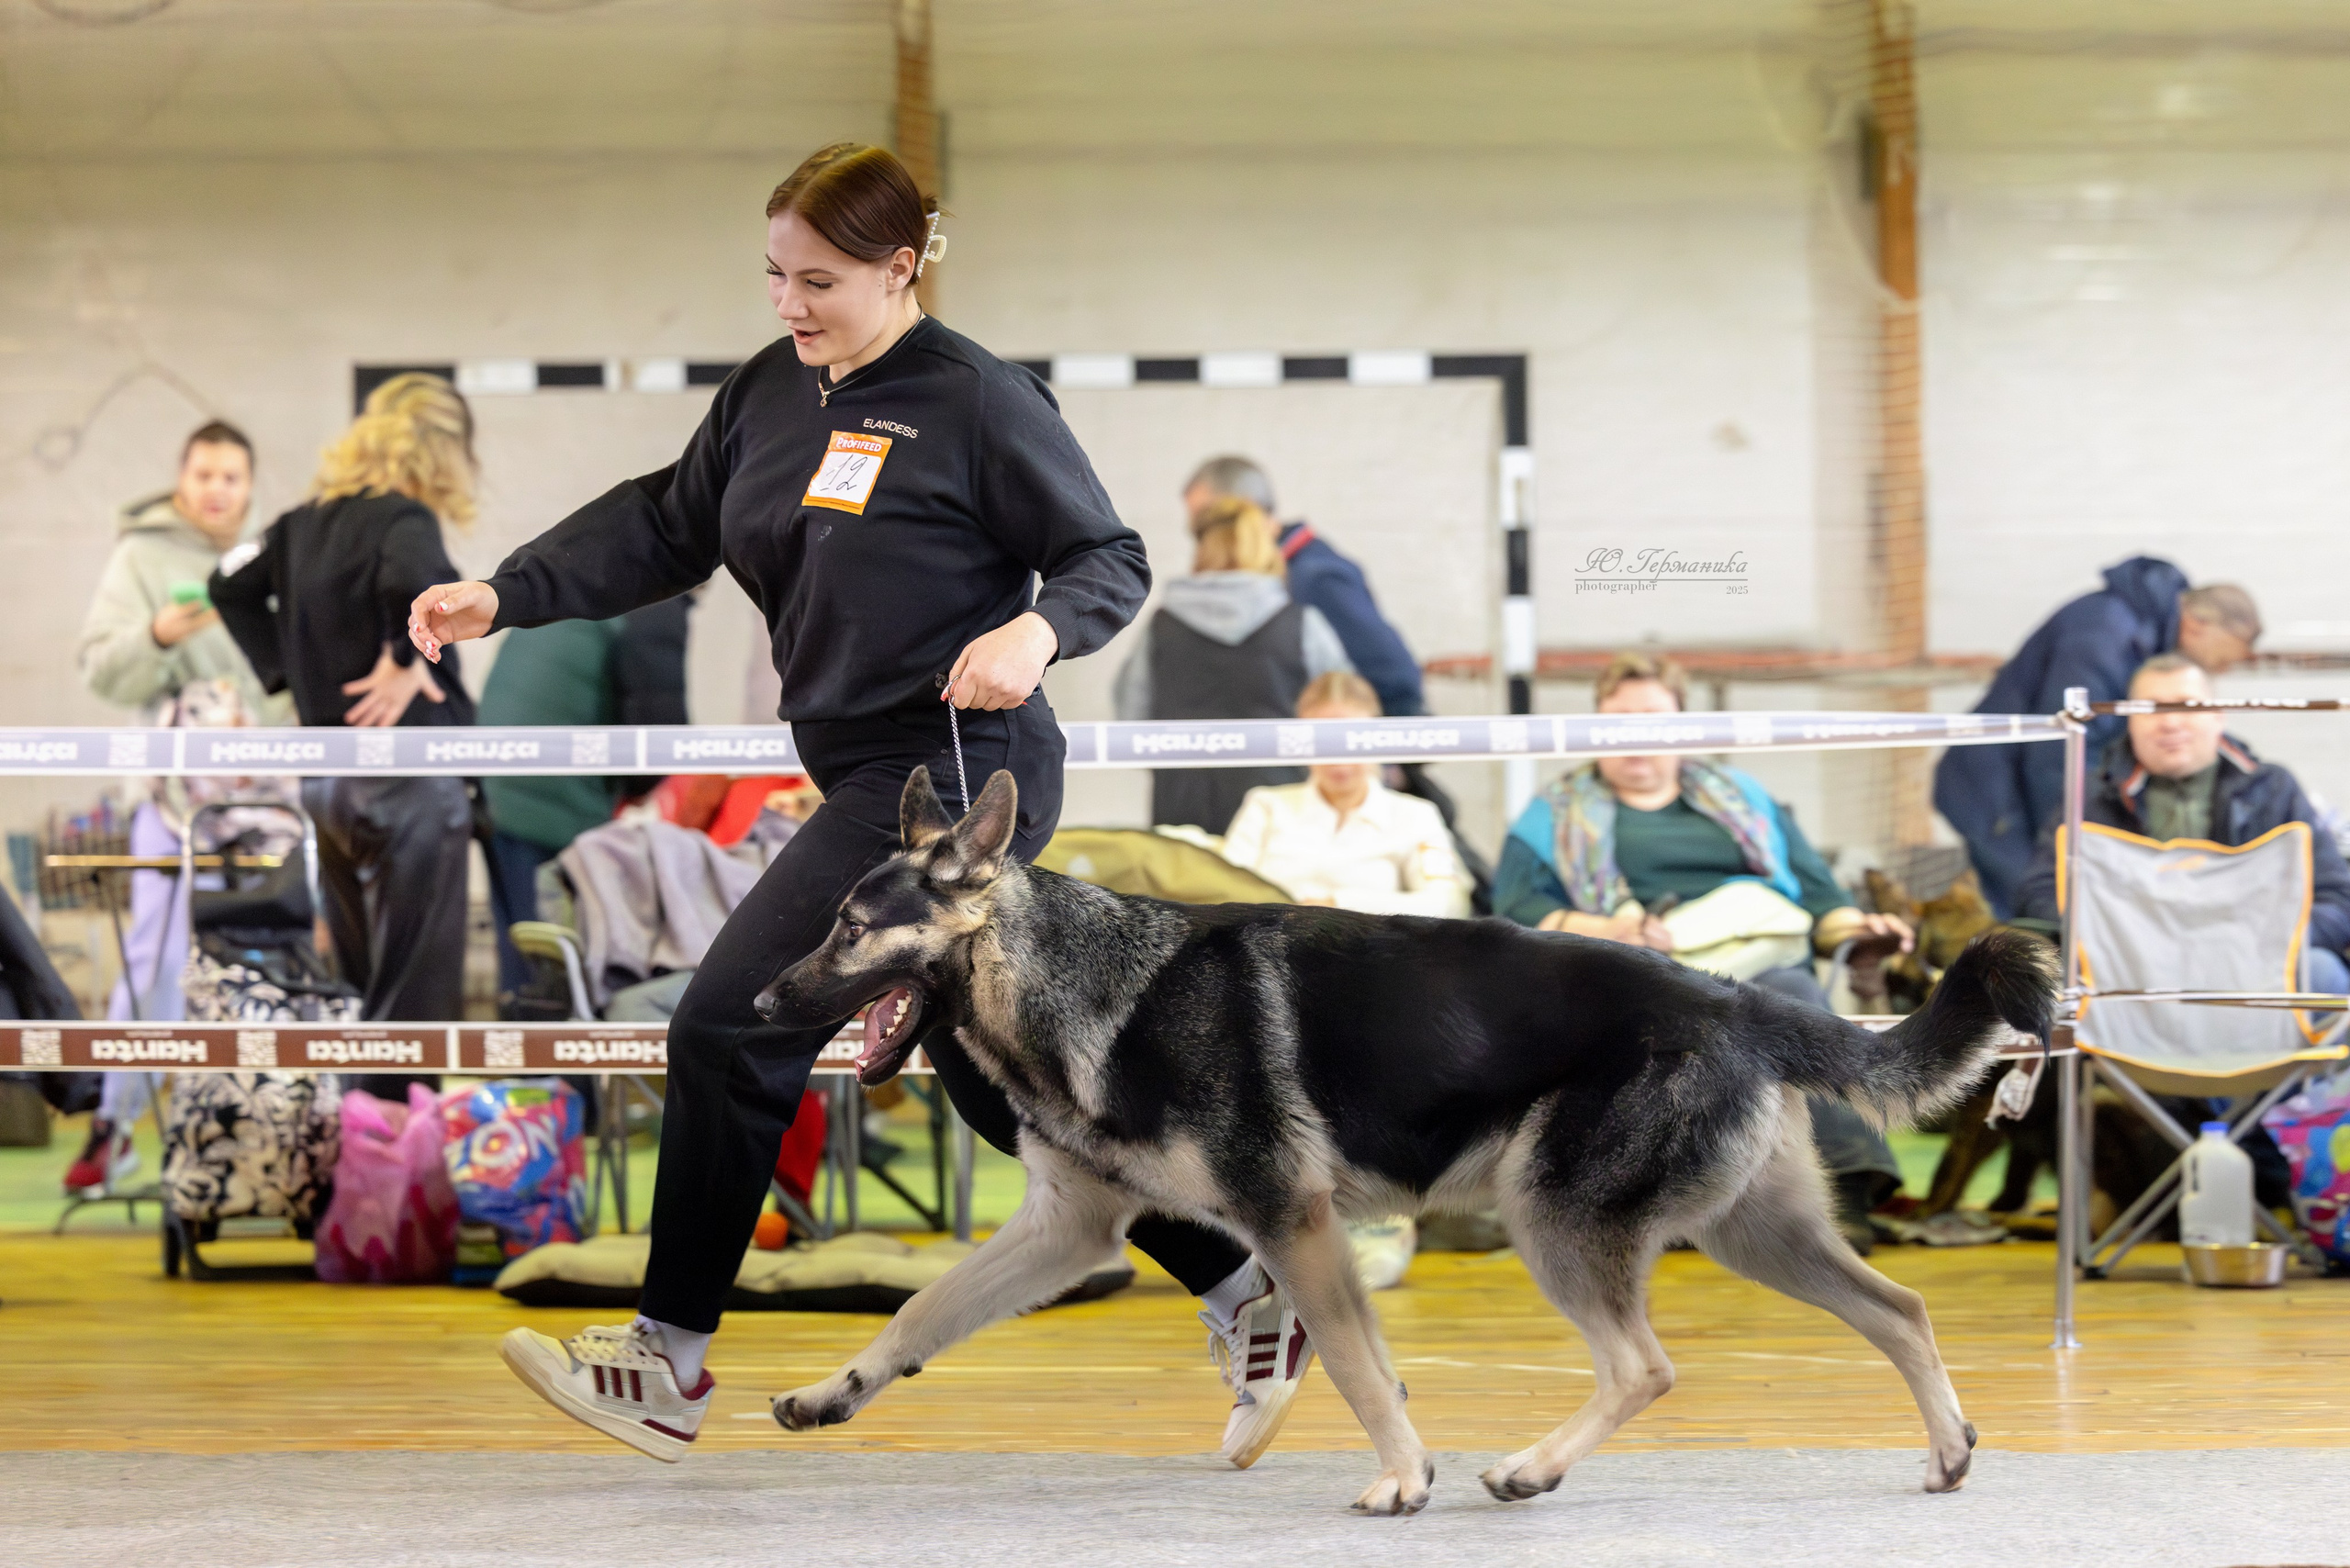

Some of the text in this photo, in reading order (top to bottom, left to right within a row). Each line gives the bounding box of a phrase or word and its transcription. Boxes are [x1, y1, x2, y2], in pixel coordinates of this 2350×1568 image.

[863, 418, 919, 439] ELANDESS
[835, 436, 883, 453] PROFIFEED
[91, 1038, 208, 1063] Hanta
[306, 1039, 424, 1064] Hanta
